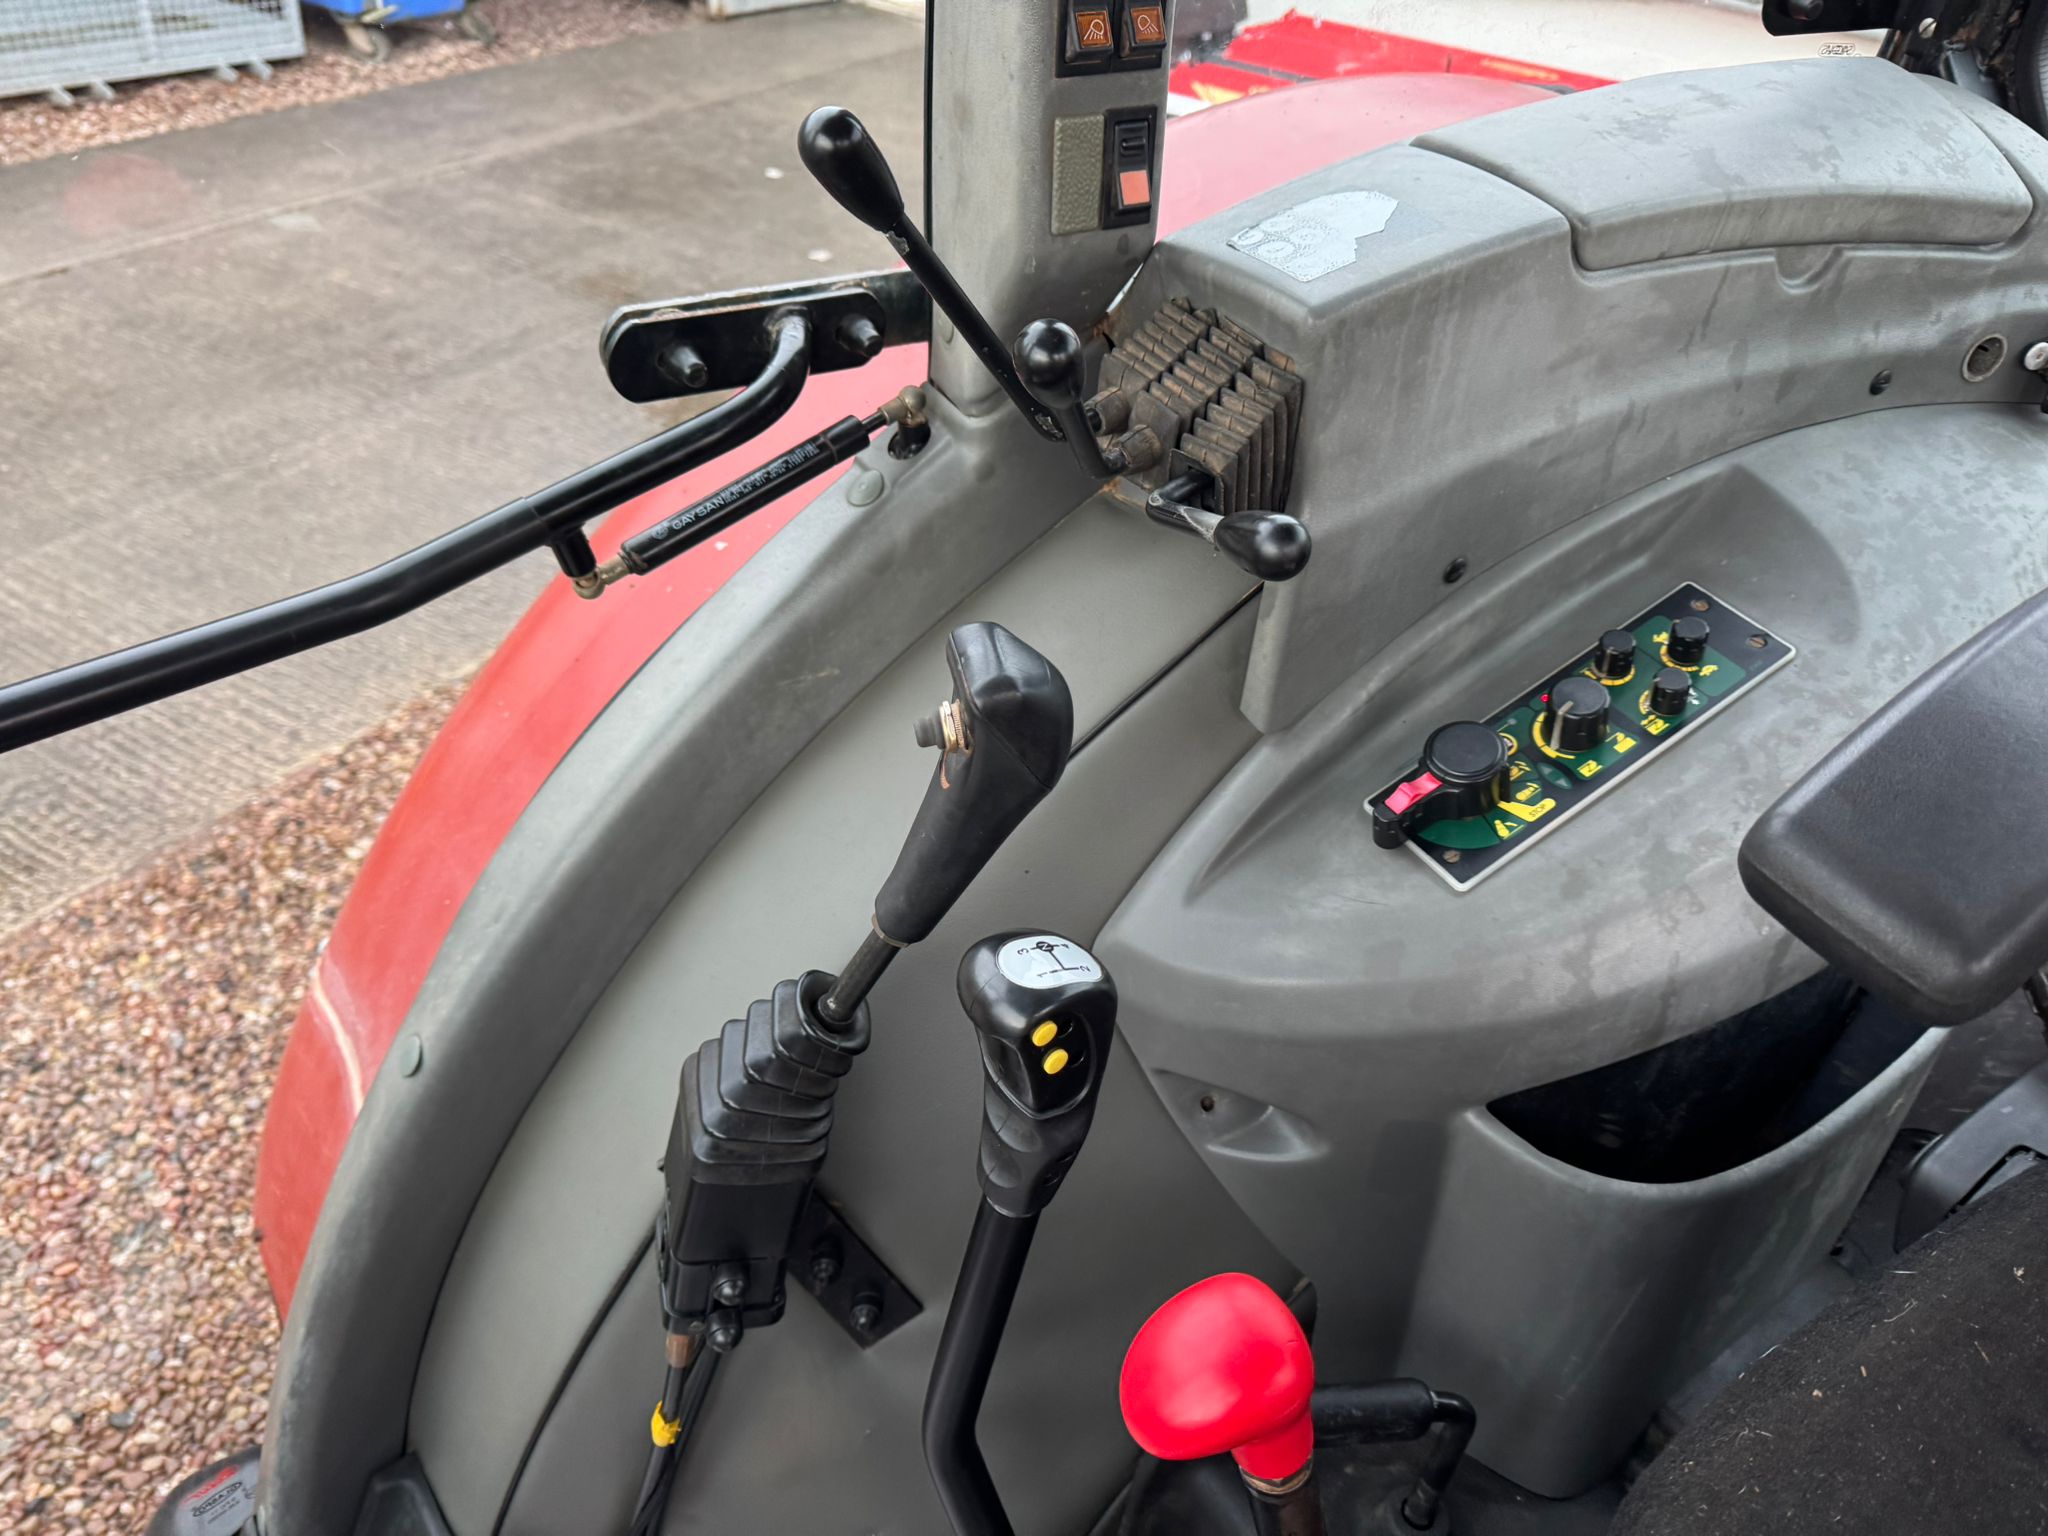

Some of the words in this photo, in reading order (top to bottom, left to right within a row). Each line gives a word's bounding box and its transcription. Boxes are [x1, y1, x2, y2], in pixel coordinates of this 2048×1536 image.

[671, 497, 726, 530] GAYSAN
[1529, 803, 1546, 818] STOP
[1017, 947, 1029, 956] 3
[1079, 965, 1091, 973] 2
